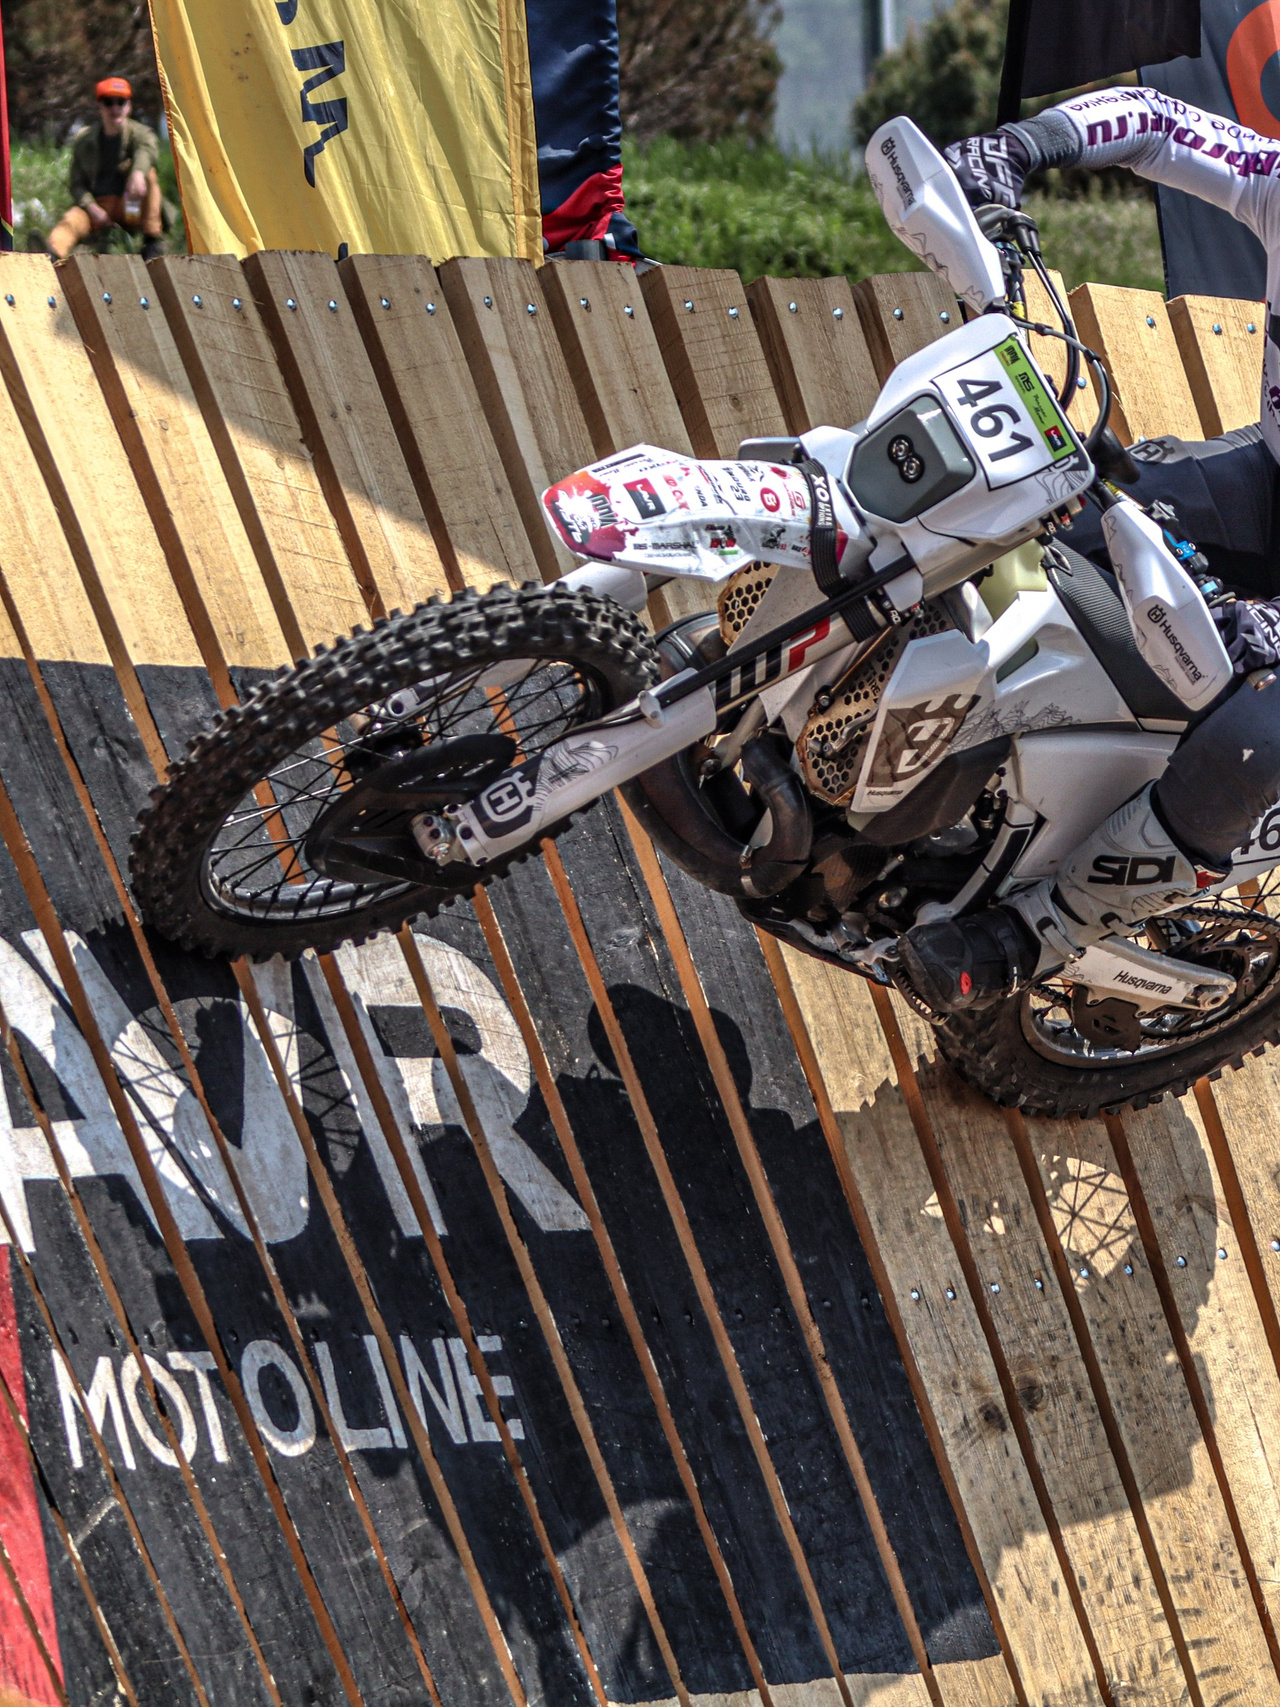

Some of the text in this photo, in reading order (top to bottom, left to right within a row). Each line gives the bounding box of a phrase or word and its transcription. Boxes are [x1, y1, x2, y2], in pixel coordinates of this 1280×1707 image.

[886, 150, 918, 207] Husqvarna
[956, 379, 1035, 463] 461
[636, 483, 657, 511] LAVR
[810, 473, 830, 502] XO
[1159, 619, 1202, 682] Husqvarna
[1086, 854, 1176, 885] SIDI
[1111, 969, 1173, 994] Husqvarna
[50, 1333, 525, 1471] MOTOLINE
